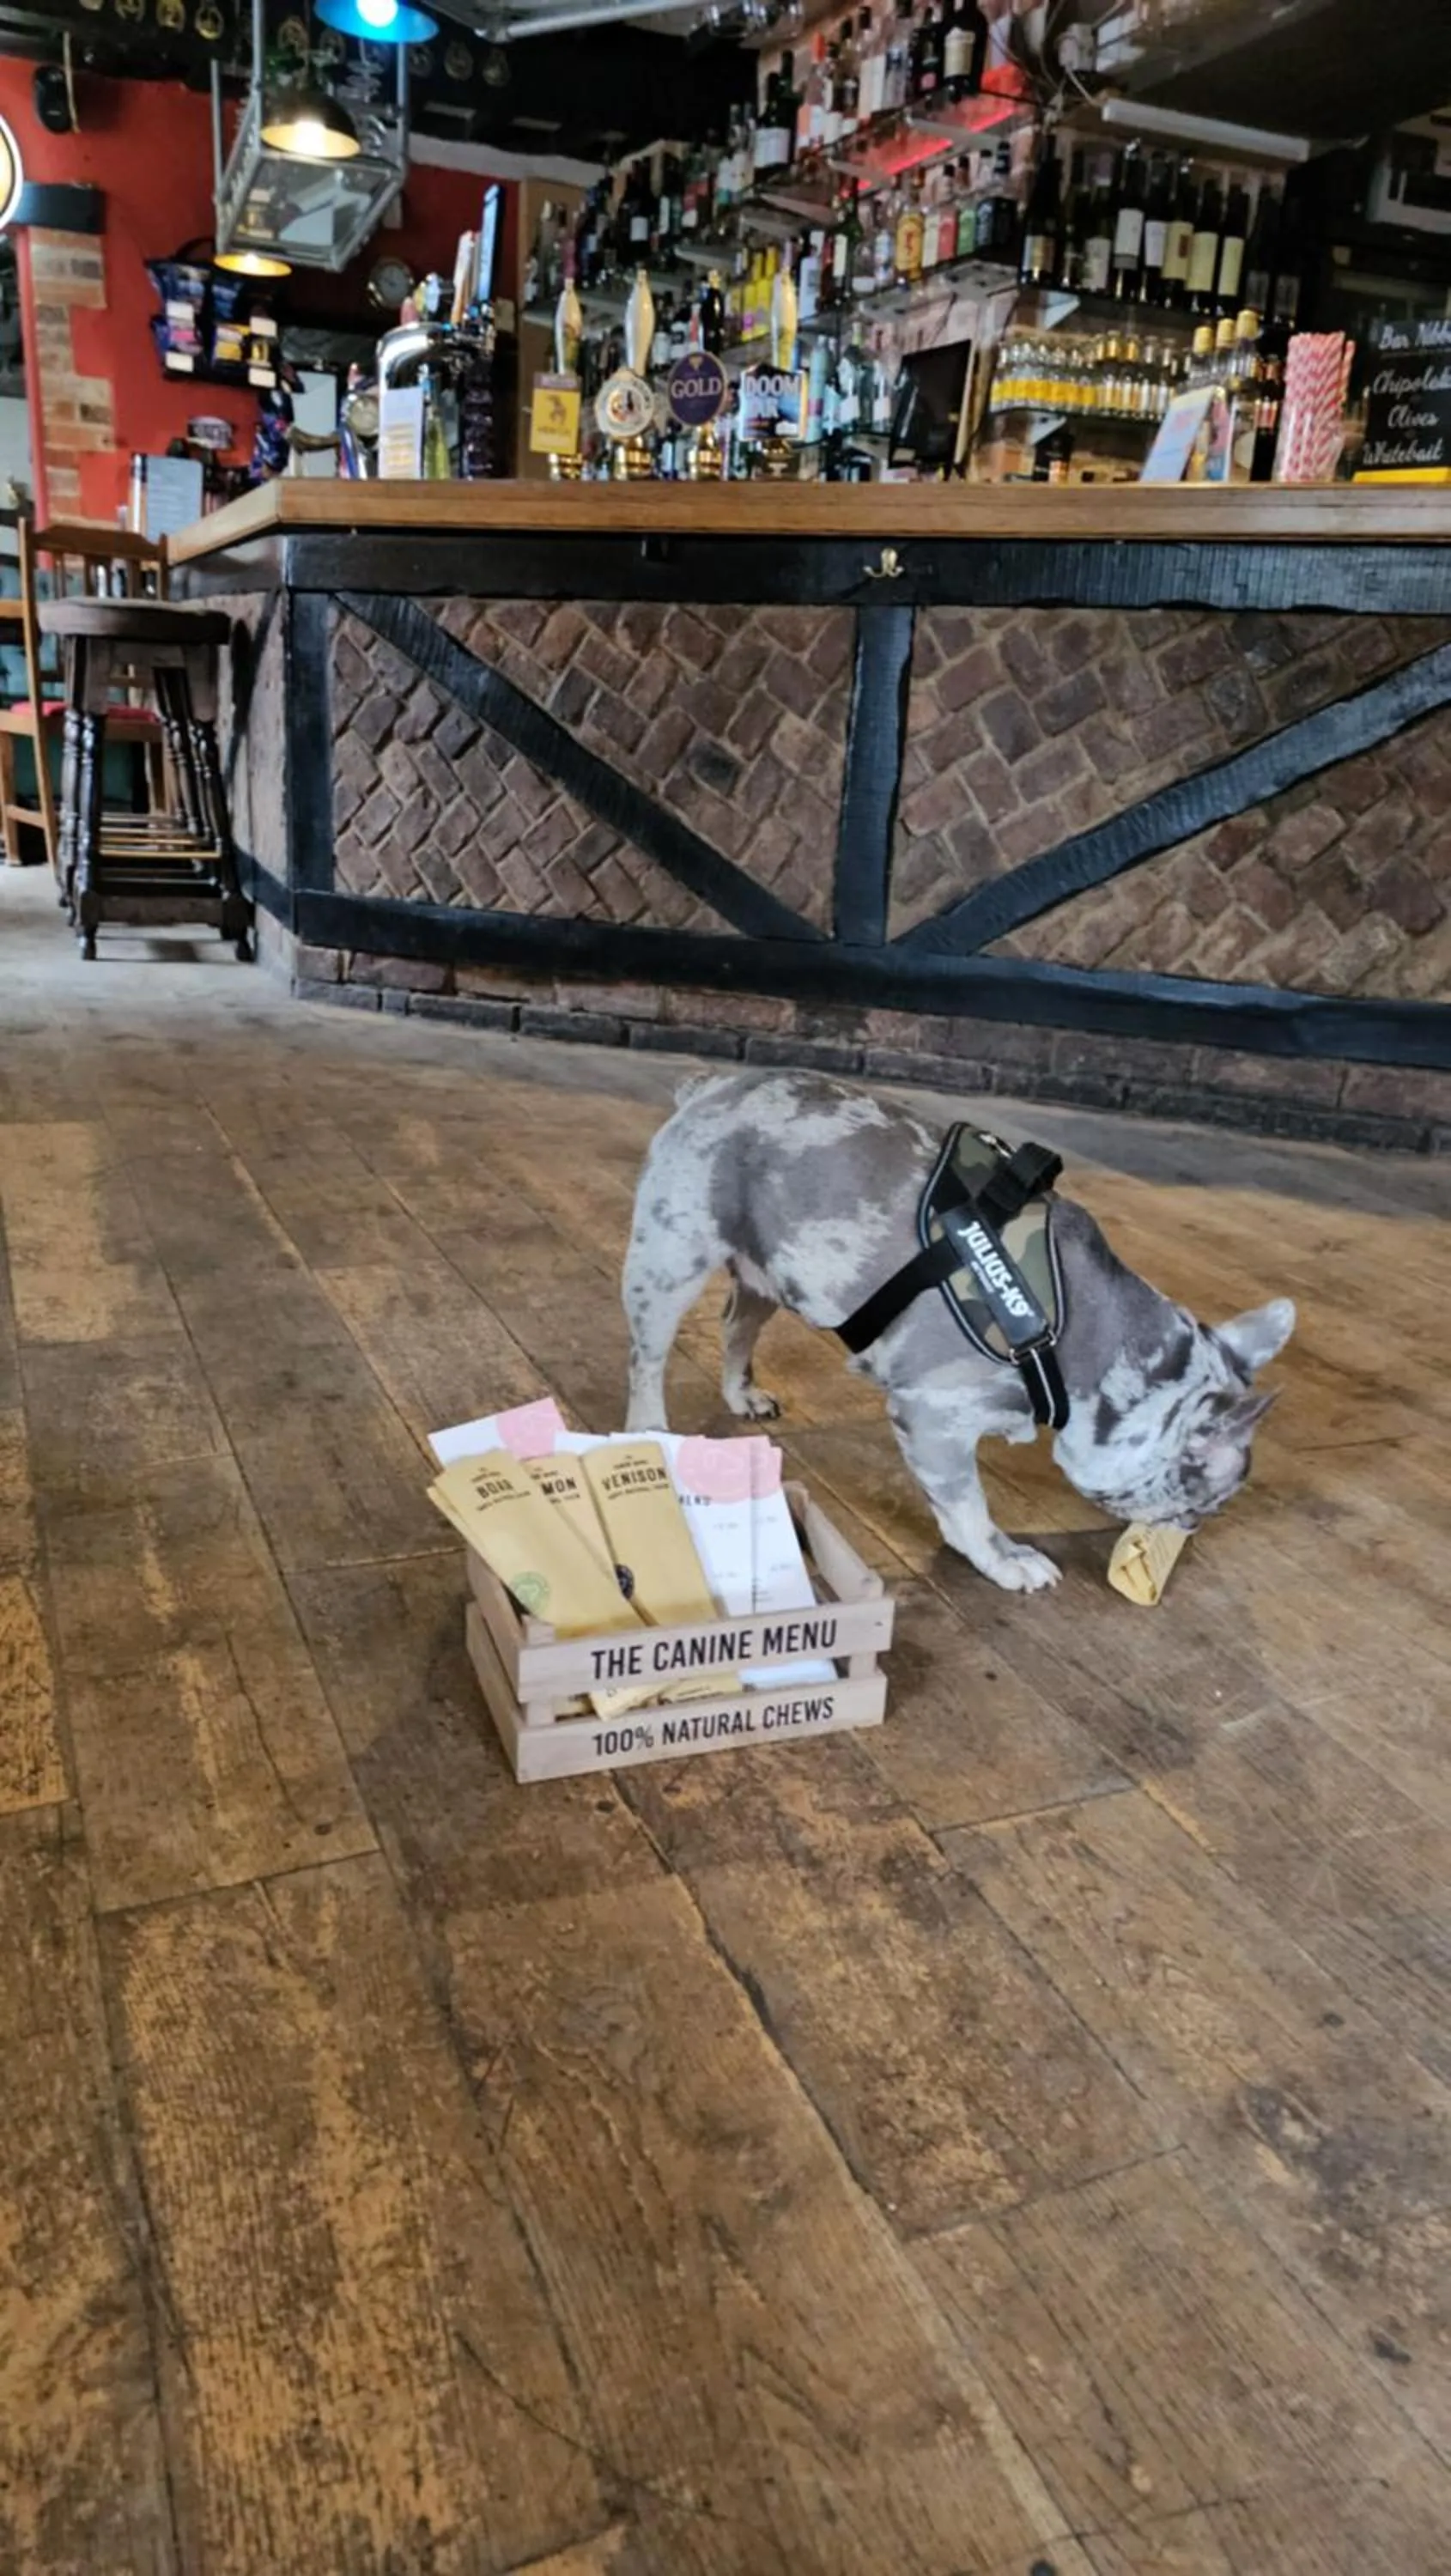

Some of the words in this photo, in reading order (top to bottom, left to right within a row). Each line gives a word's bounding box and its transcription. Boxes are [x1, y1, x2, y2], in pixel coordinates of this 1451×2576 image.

[671, 376, 723, 399] GOLD
[746, 374, 799, 398] DOOM
[541, 1476, 577, 1496] MON
[602, 1467, 667, 1492] VENISON
[591, 1645, 643, 1680] THE
[653, 1630, 753, 1672] CANINE
[762, 1619, 837, 1656] MENU
[592, 1728, 654, 1756] 100%
[662, 1709, 756, 1745] NATURAL
[762, 1696, 835, 1729] CHEWS
